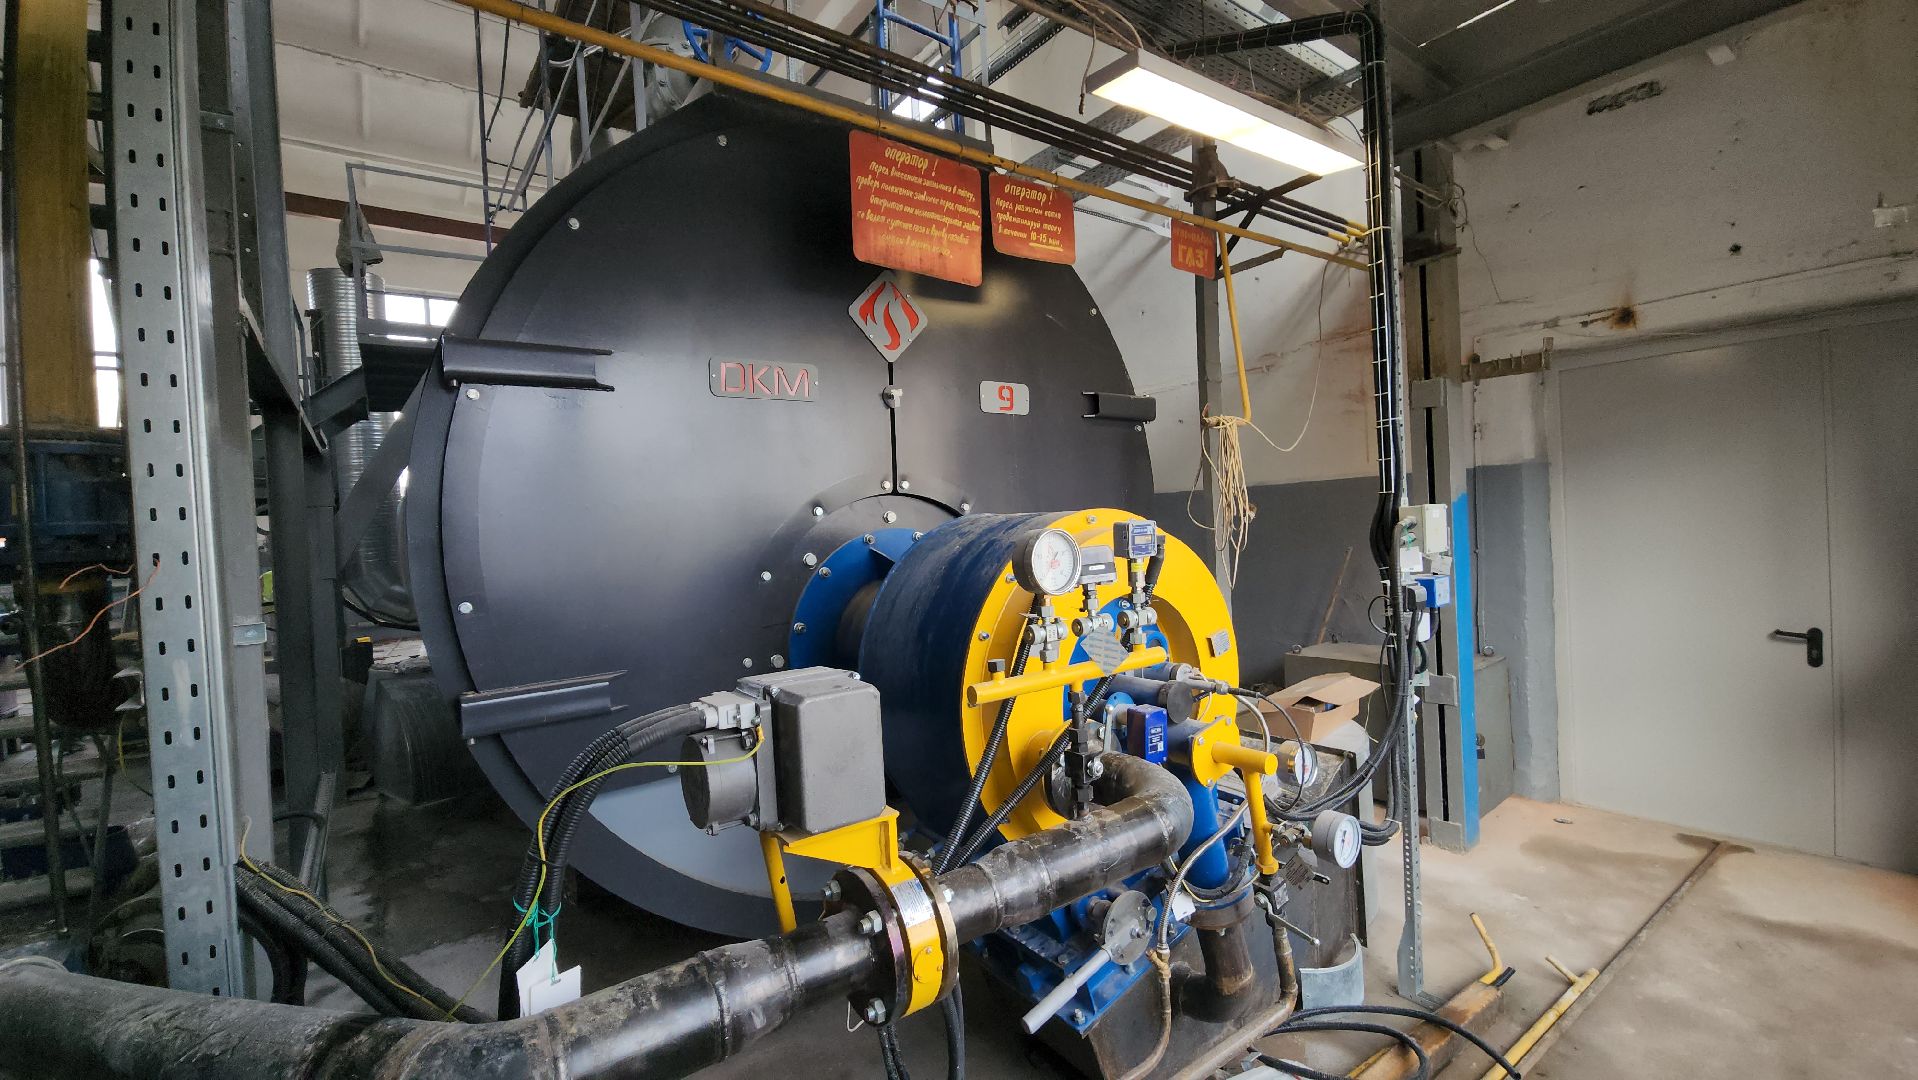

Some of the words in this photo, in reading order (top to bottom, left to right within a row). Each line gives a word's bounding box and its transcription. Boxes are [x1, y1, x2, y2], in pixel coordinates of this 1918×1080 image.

[1030, 230, 1048, 243] 10-15
[720, 361, 811, 398] DKM
[997, 384, 1014, 411] 9
